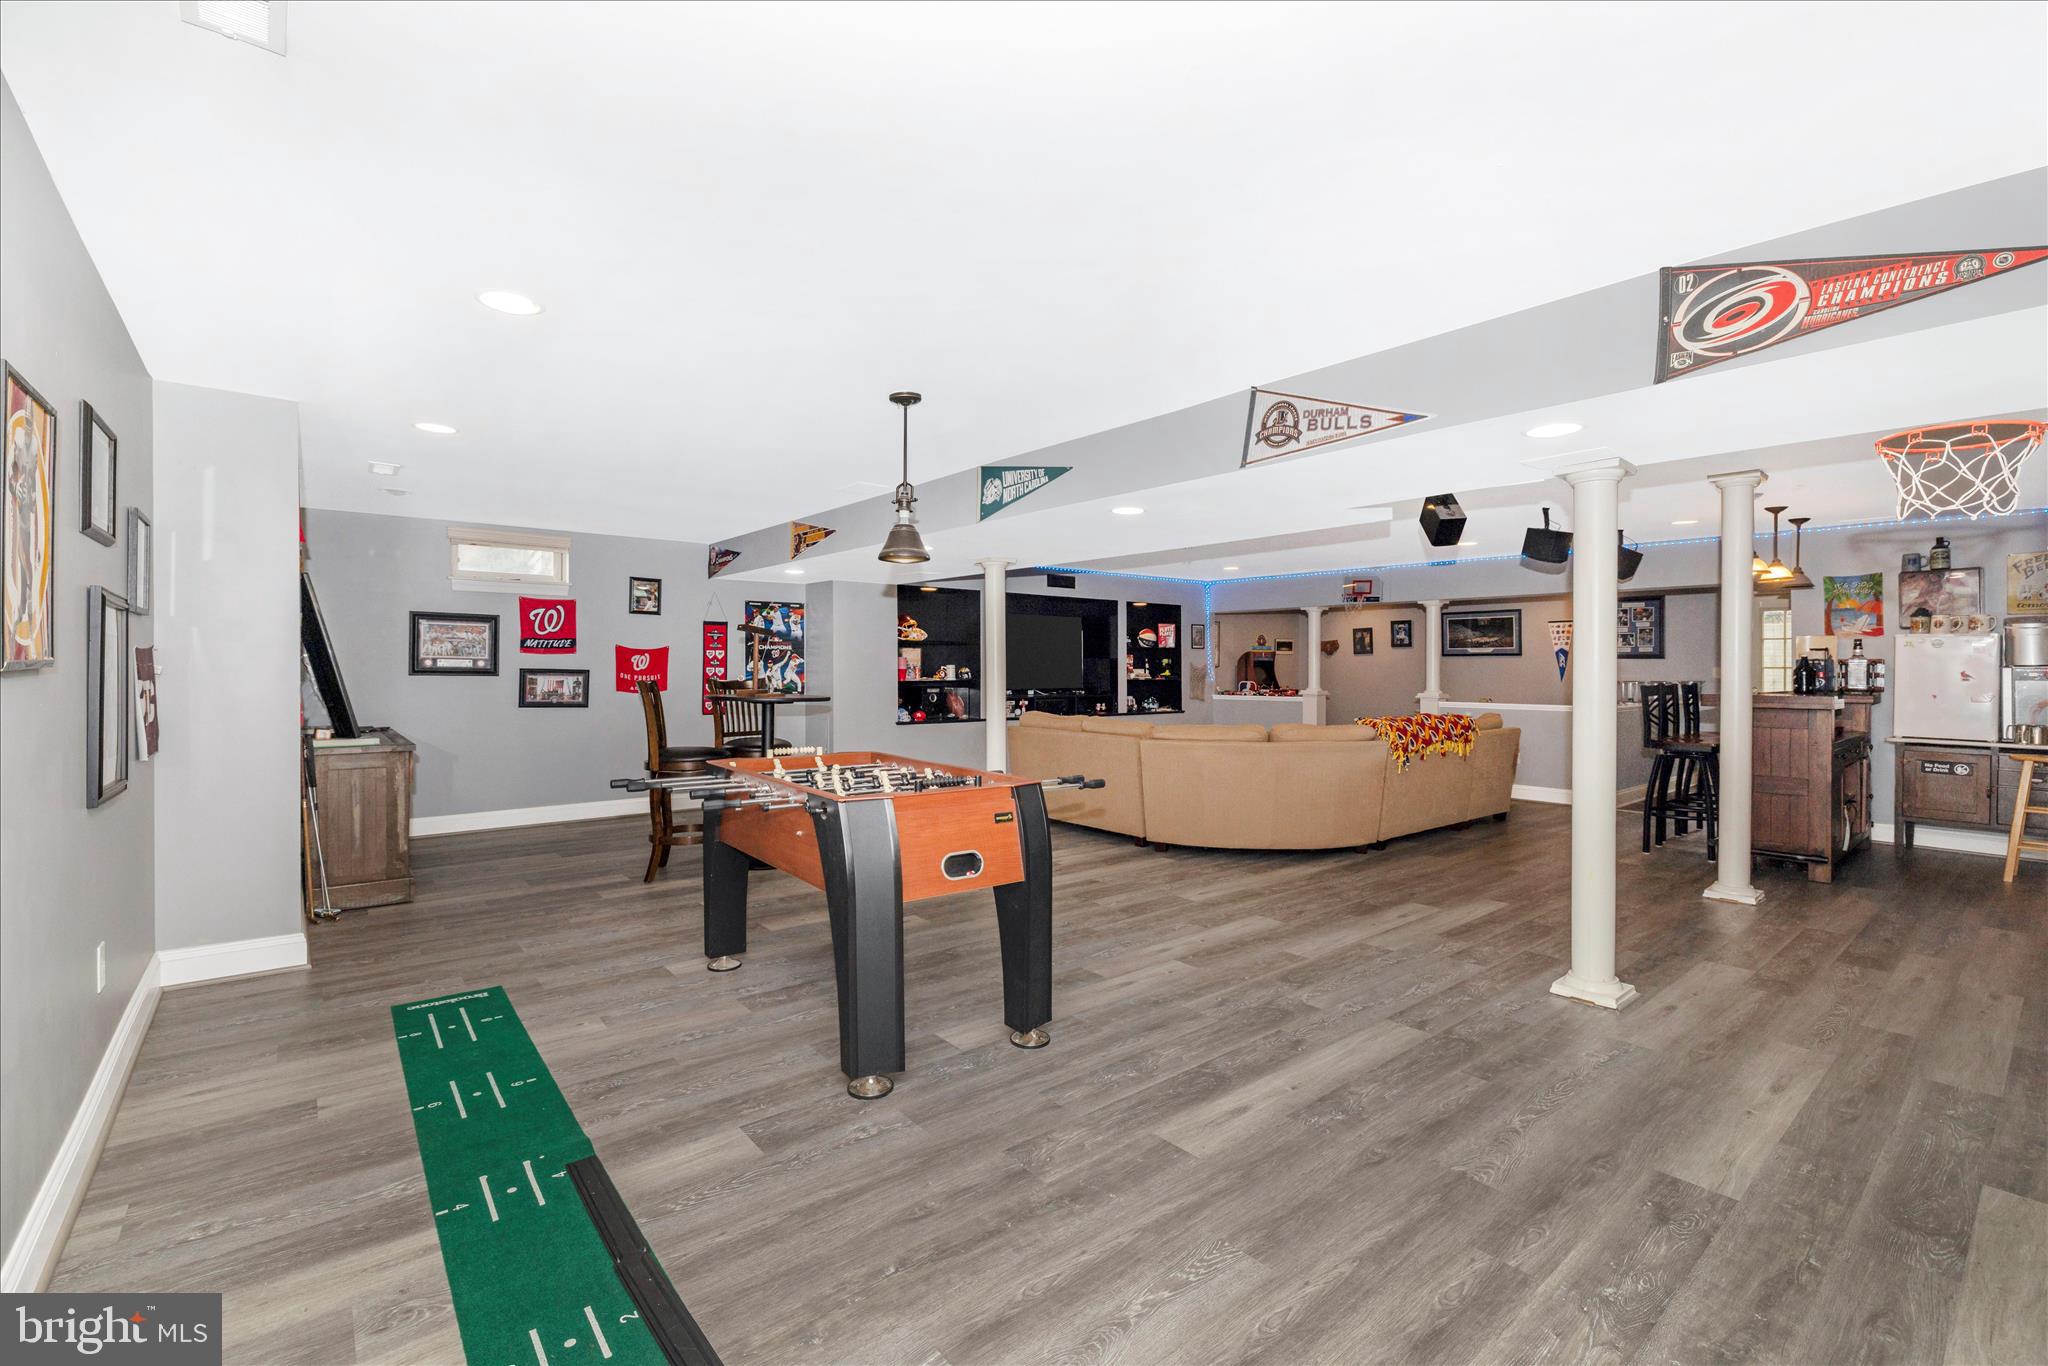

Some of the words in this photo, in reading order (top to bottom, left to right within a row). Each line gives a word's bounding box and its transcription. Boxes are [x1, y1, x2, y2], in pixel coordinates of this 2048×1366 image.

[1679, 273, 1694, 294] 02
[1821, 275, 1868, 295] EASTERN
[1873, 260, 1949, 285] CONFERENCE
[1817, 271, 1949, 307] CHAMPIONS
[1303, 407, 1349, 419] DURHAM
[1306, 414, 1373, 432] BULLS
[1260, 426, 1298, 439] CHAMPIONS
[1002, 469, 1039, 488] UNIVERSITY
[1038, 468, 1045, 478] OF
[1002, 482, 1023, 505] NORTH
[1024, 476, 1049, 494] CAROLINA
[529, 605, 565, 635] W
[524, 638, 573, 648] NATITUDE
[620, 672, 631, 681] ONE
[634, 673, 661, 682] PURSUIT
